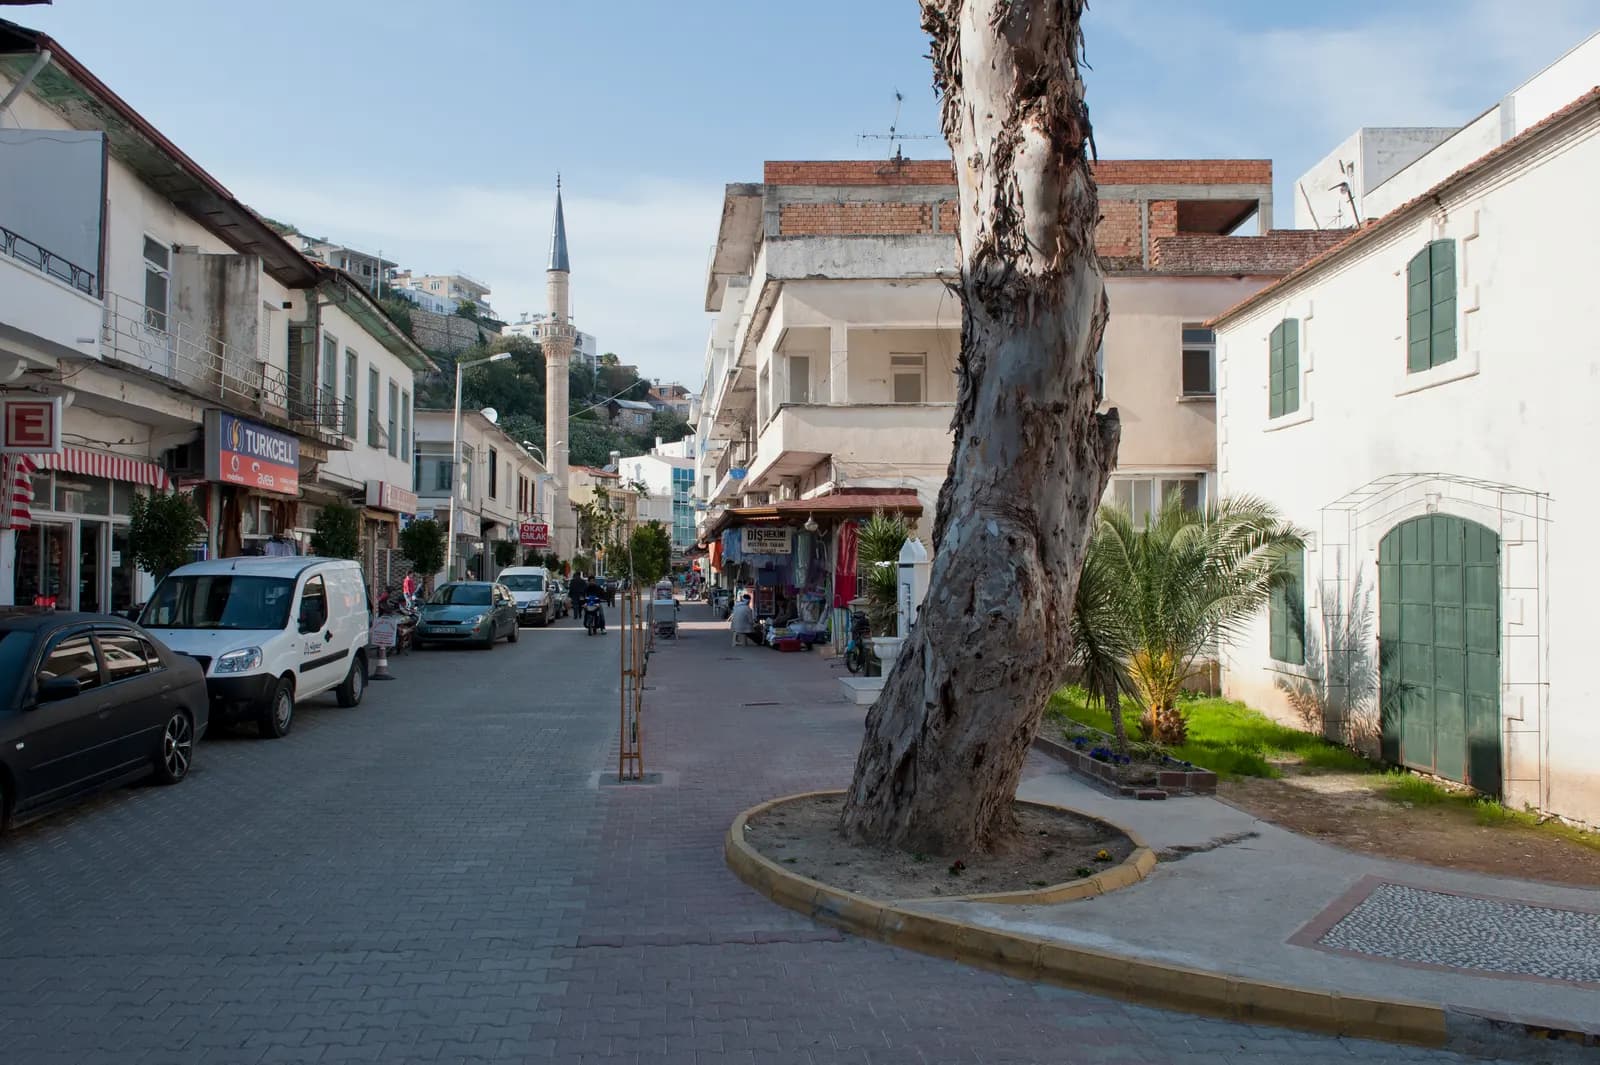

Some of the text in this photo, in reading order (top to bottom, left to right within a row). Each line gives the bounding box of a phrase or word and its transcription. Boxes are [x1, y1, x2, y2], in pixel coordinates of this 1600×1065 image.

[15, 408, 44, 441] E
[245, 429, 294, 465] TURKCELL
[521, 532, 546, 540] EMLAK
